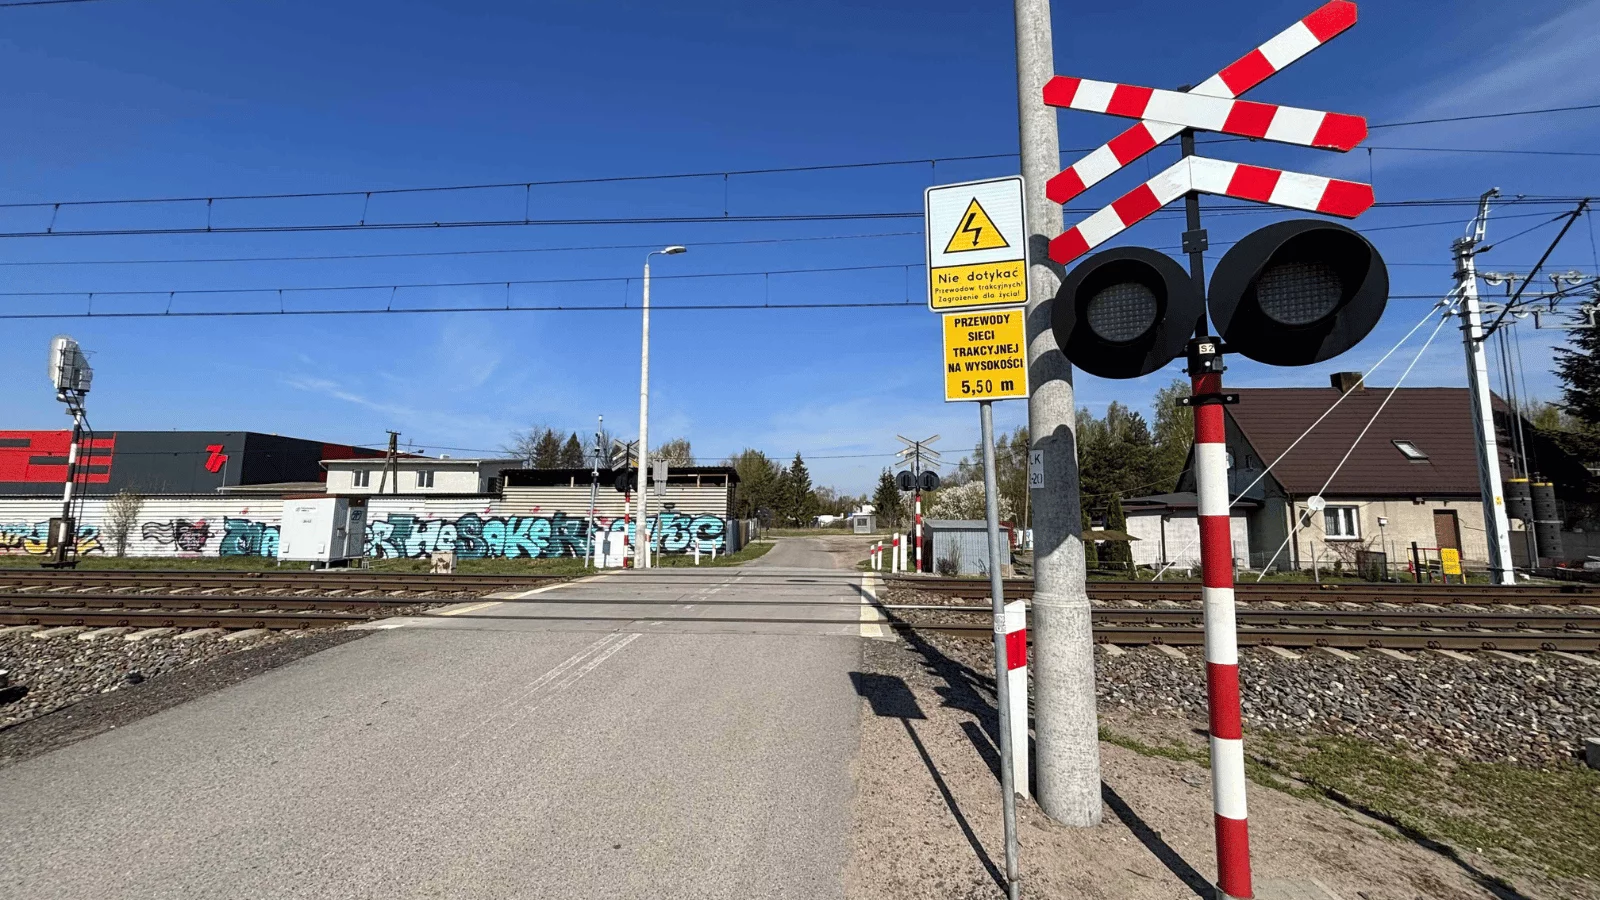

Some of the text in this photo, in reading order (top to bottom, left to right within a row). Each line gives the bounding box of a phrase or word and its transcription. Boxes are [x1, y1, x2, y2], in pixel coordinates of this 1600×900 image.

[938, 267, 1018, 284] Nie dotykać
[954, 314, 1010, 328] PRZEWODY
[968, 330, 995, 342] SIECI
[953, 343, 1019, 357] TRAKCYJNEJ
[948, 356, 1024, 373] NA WYSOKOŚCI
[961, 379, 1014, 396] 5,50 m
